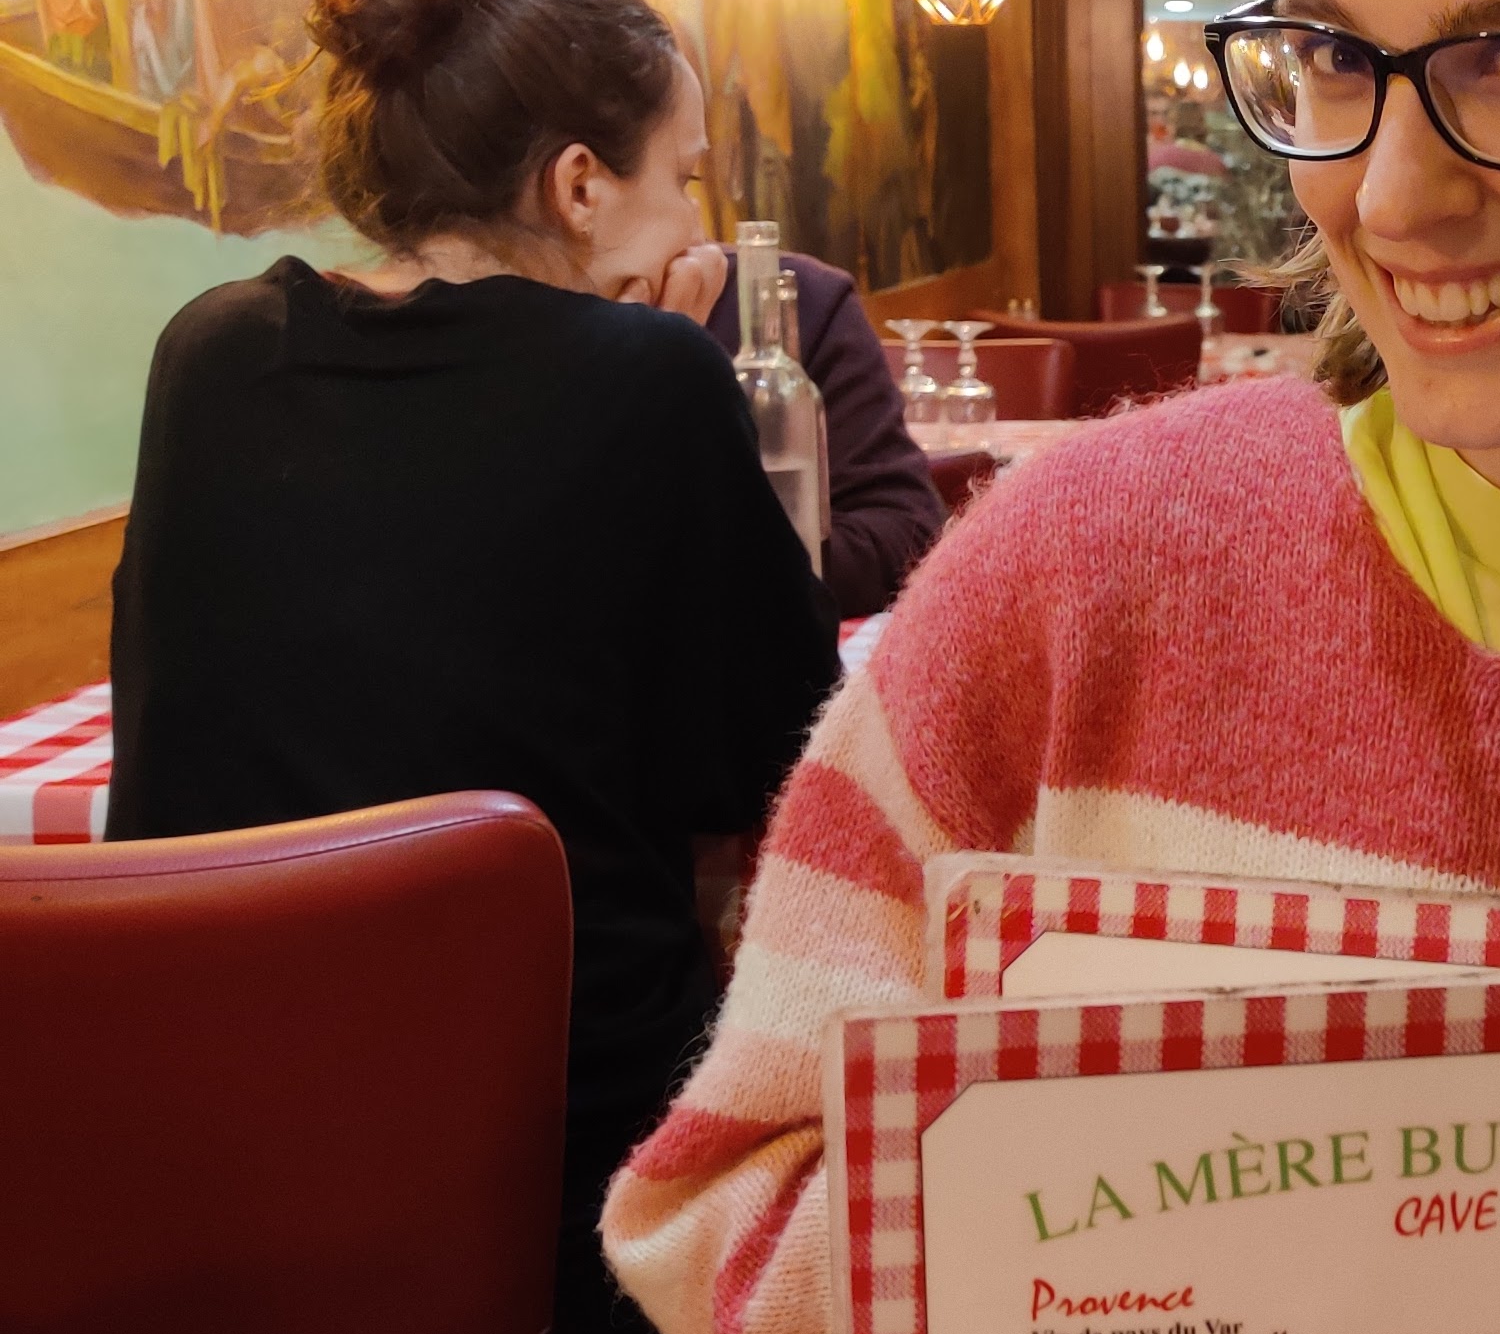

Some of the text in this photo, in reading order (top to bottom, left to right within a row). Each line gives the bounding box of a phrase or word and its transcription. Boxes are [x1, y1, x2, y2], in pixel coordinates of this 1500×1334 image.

[1024, 1173, 1135, 1243] LA
[1152, 1130, 1374, 1212] MÈRE
[1394, 1190, 1498, 1237] CAVE
[1031, 1277, 1196, 1322] Provence
